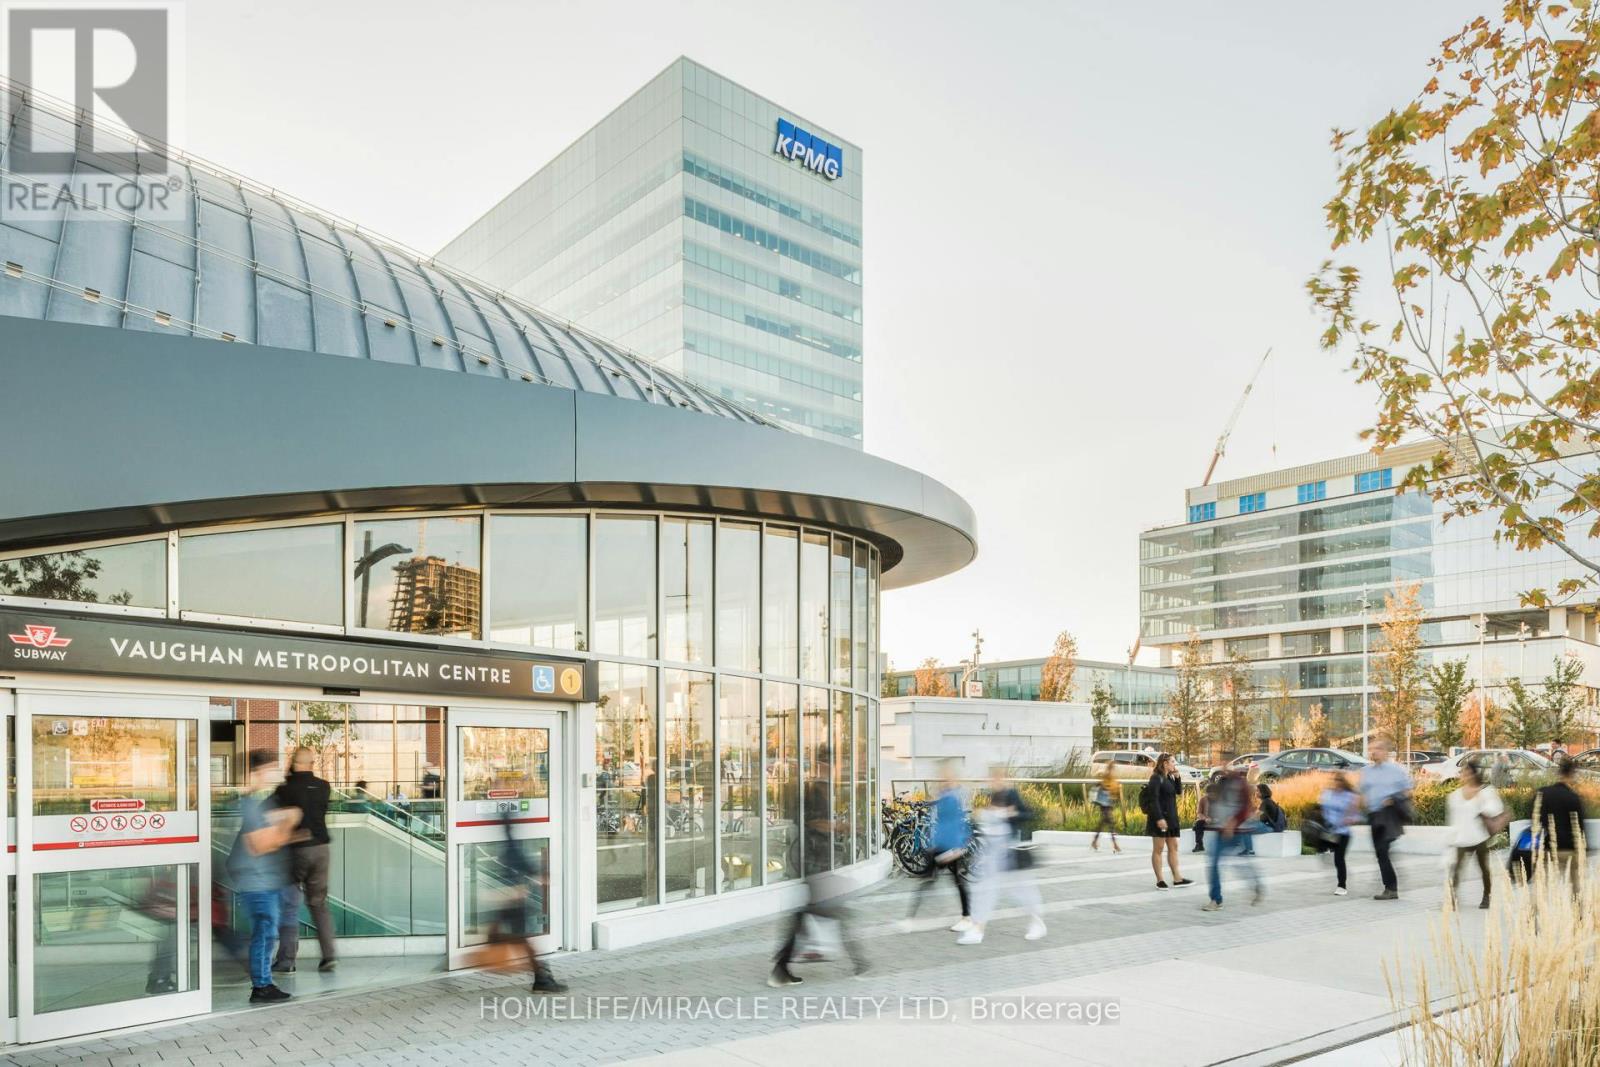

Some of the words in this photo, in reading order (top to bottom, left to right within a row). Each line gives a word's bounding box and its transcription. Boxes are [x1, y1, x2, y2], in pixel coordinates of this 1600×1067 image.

[775, 132, 839, 180] KPMG
[14, 648, 68, 661] SUBWAY
[109, 637, 243, 665] VAUGHAN
[254, 649, 430, 679] METROPOLITAN
[439, 664, 511, 684] CENTRE
